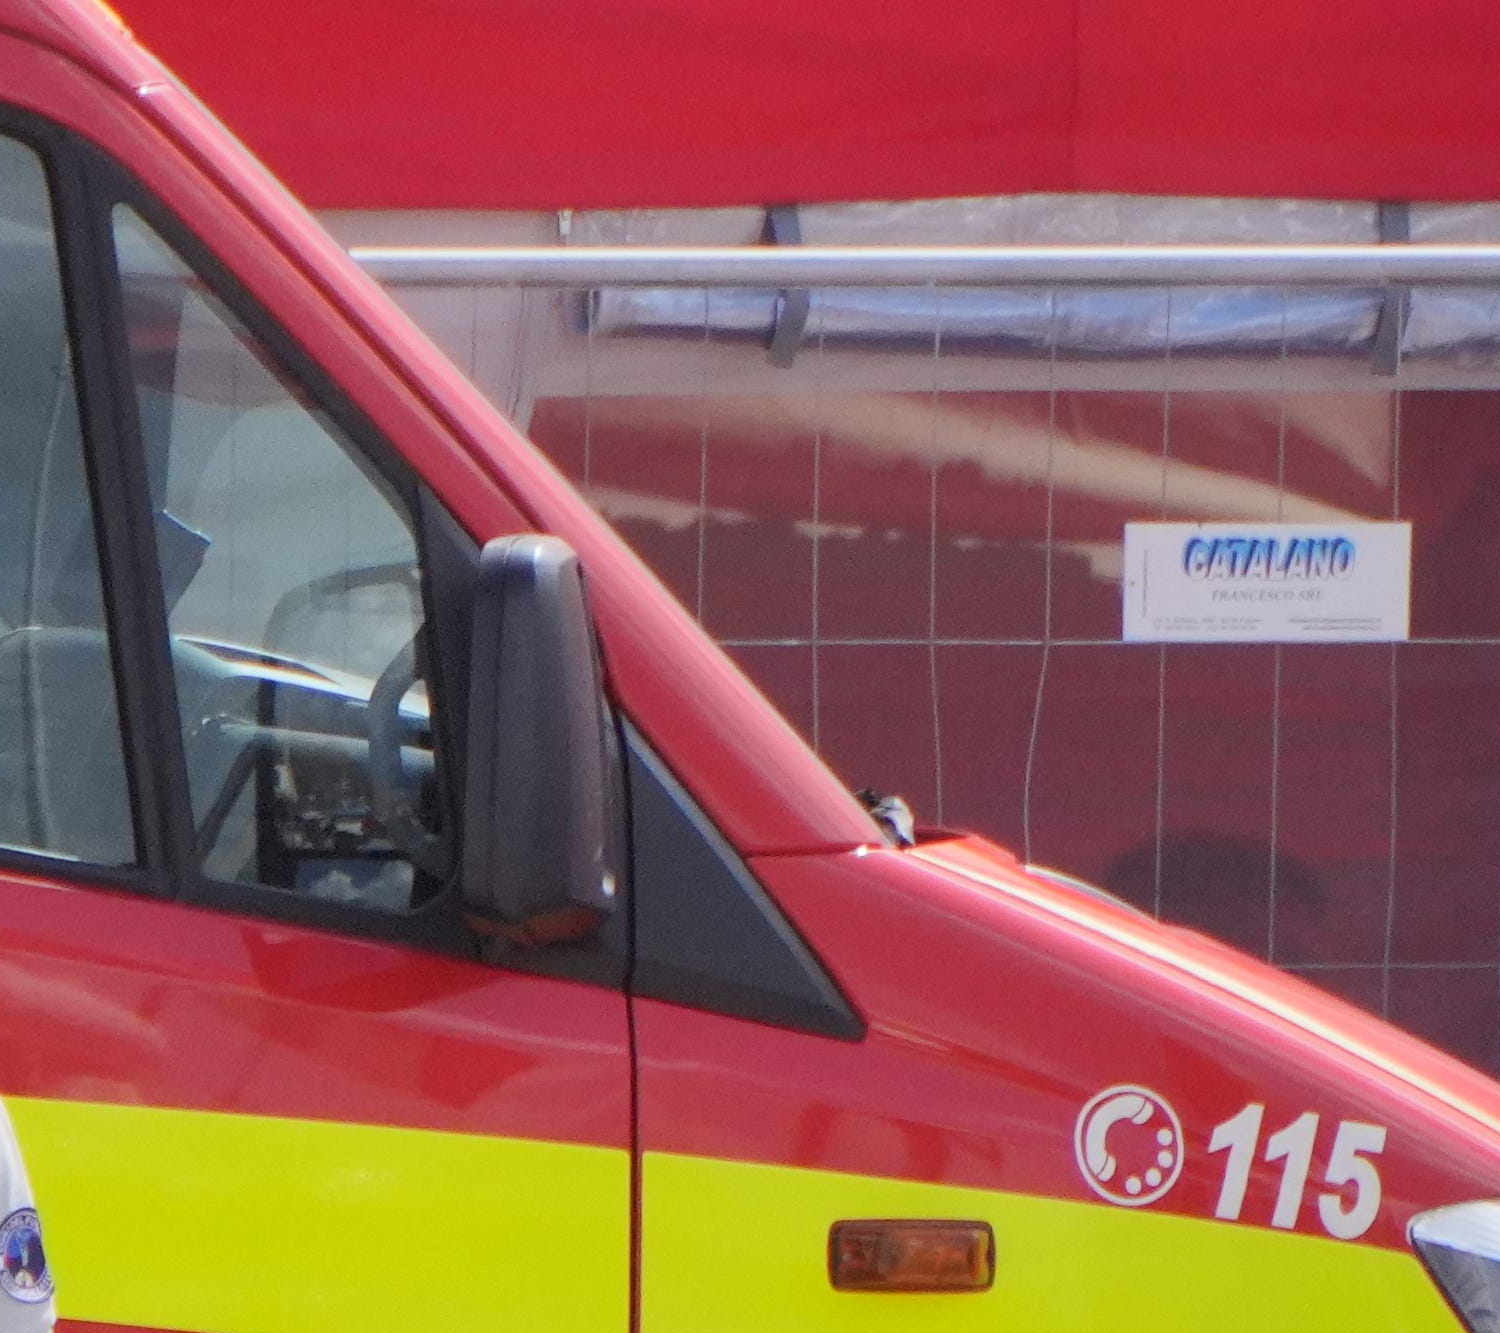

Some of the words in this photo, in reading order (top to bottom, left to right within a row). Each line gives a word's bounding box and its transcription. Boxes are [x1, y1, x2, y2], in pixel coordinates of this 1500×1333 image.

[1181, 534, 1357, 582] CATALANO
[1210, 589, 1297, 603] FRANCESCO
[1207, 1103, 1388, 1240] 115
